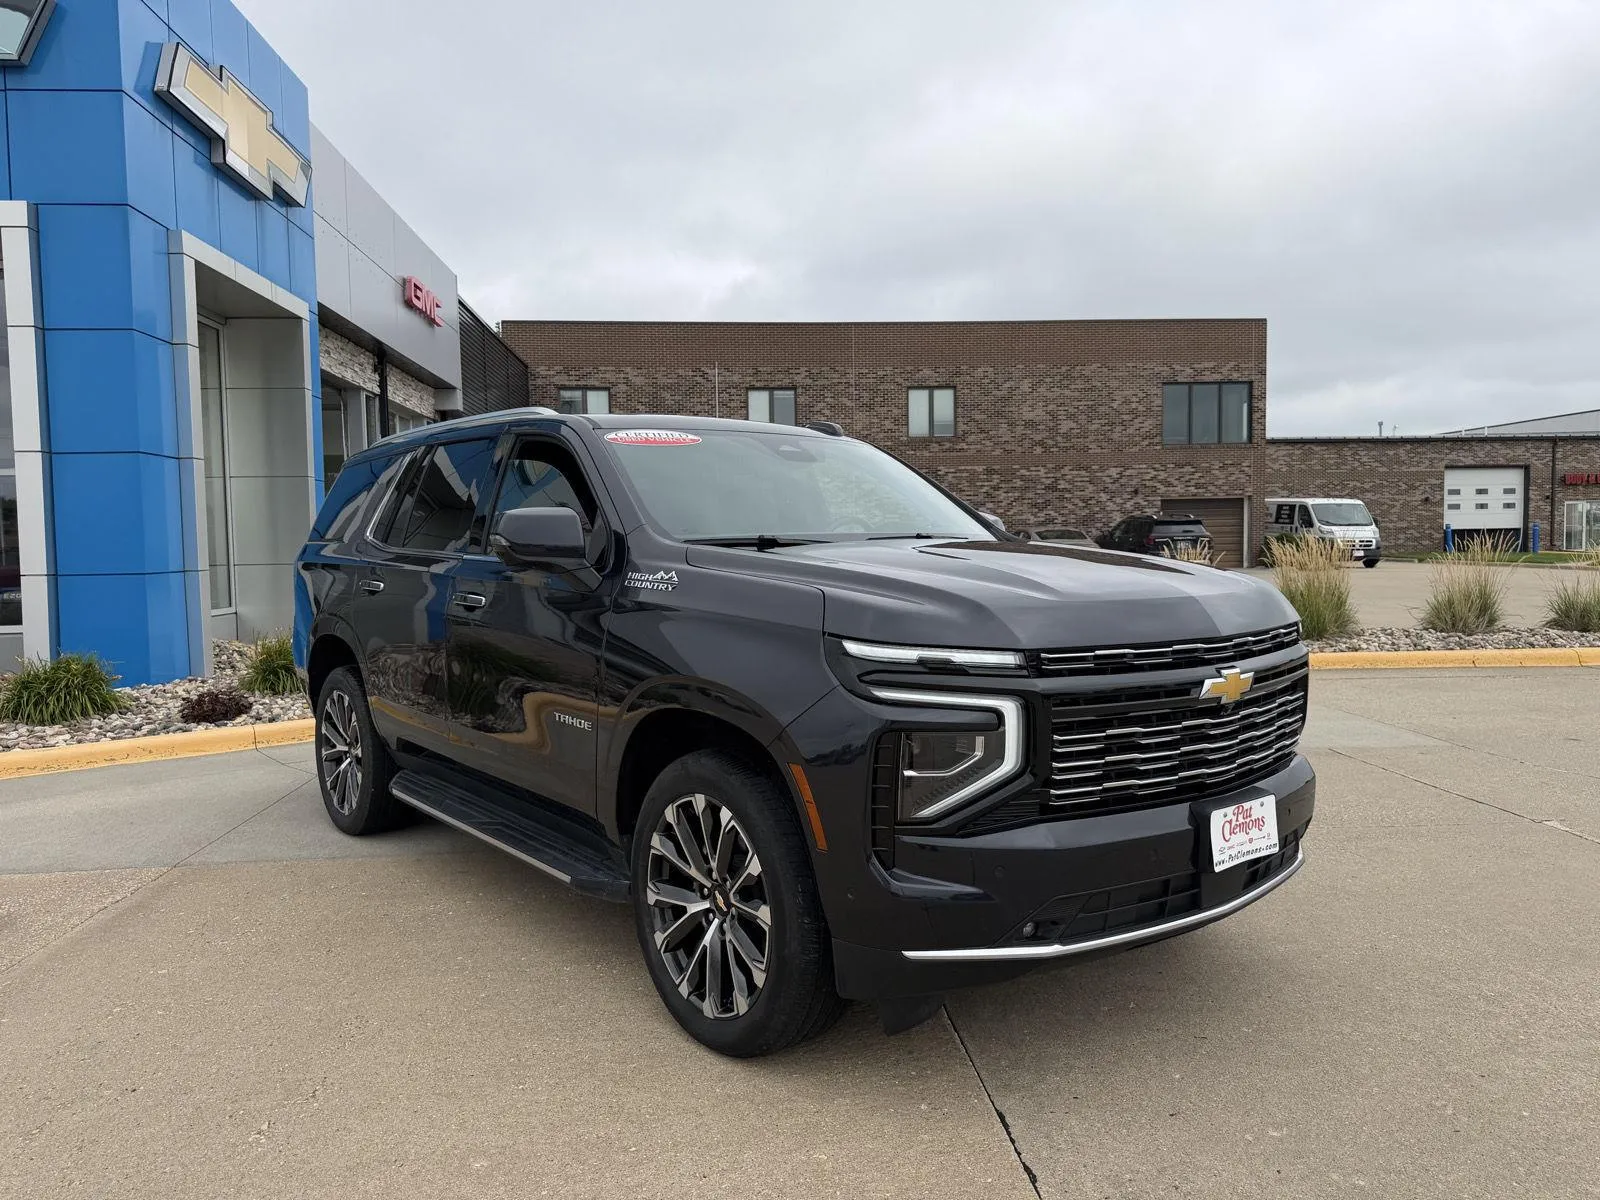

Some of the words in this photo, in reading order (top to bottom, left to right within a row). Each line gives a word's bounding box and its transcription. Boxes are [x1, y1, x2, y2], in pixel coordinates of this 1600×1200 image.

[406, 275, 443, 328] GMC
[625, 580, 678, 591] COUNTRY
[627, 571, 654, 581] HIGH
[553, 711, 592, 731] TAHOE
[1232, 804, 1253, 822] Pat
[1221, 815, 1266, 842] Clemons
[1215, 842, 1278, 867] www.PatClemons.com
